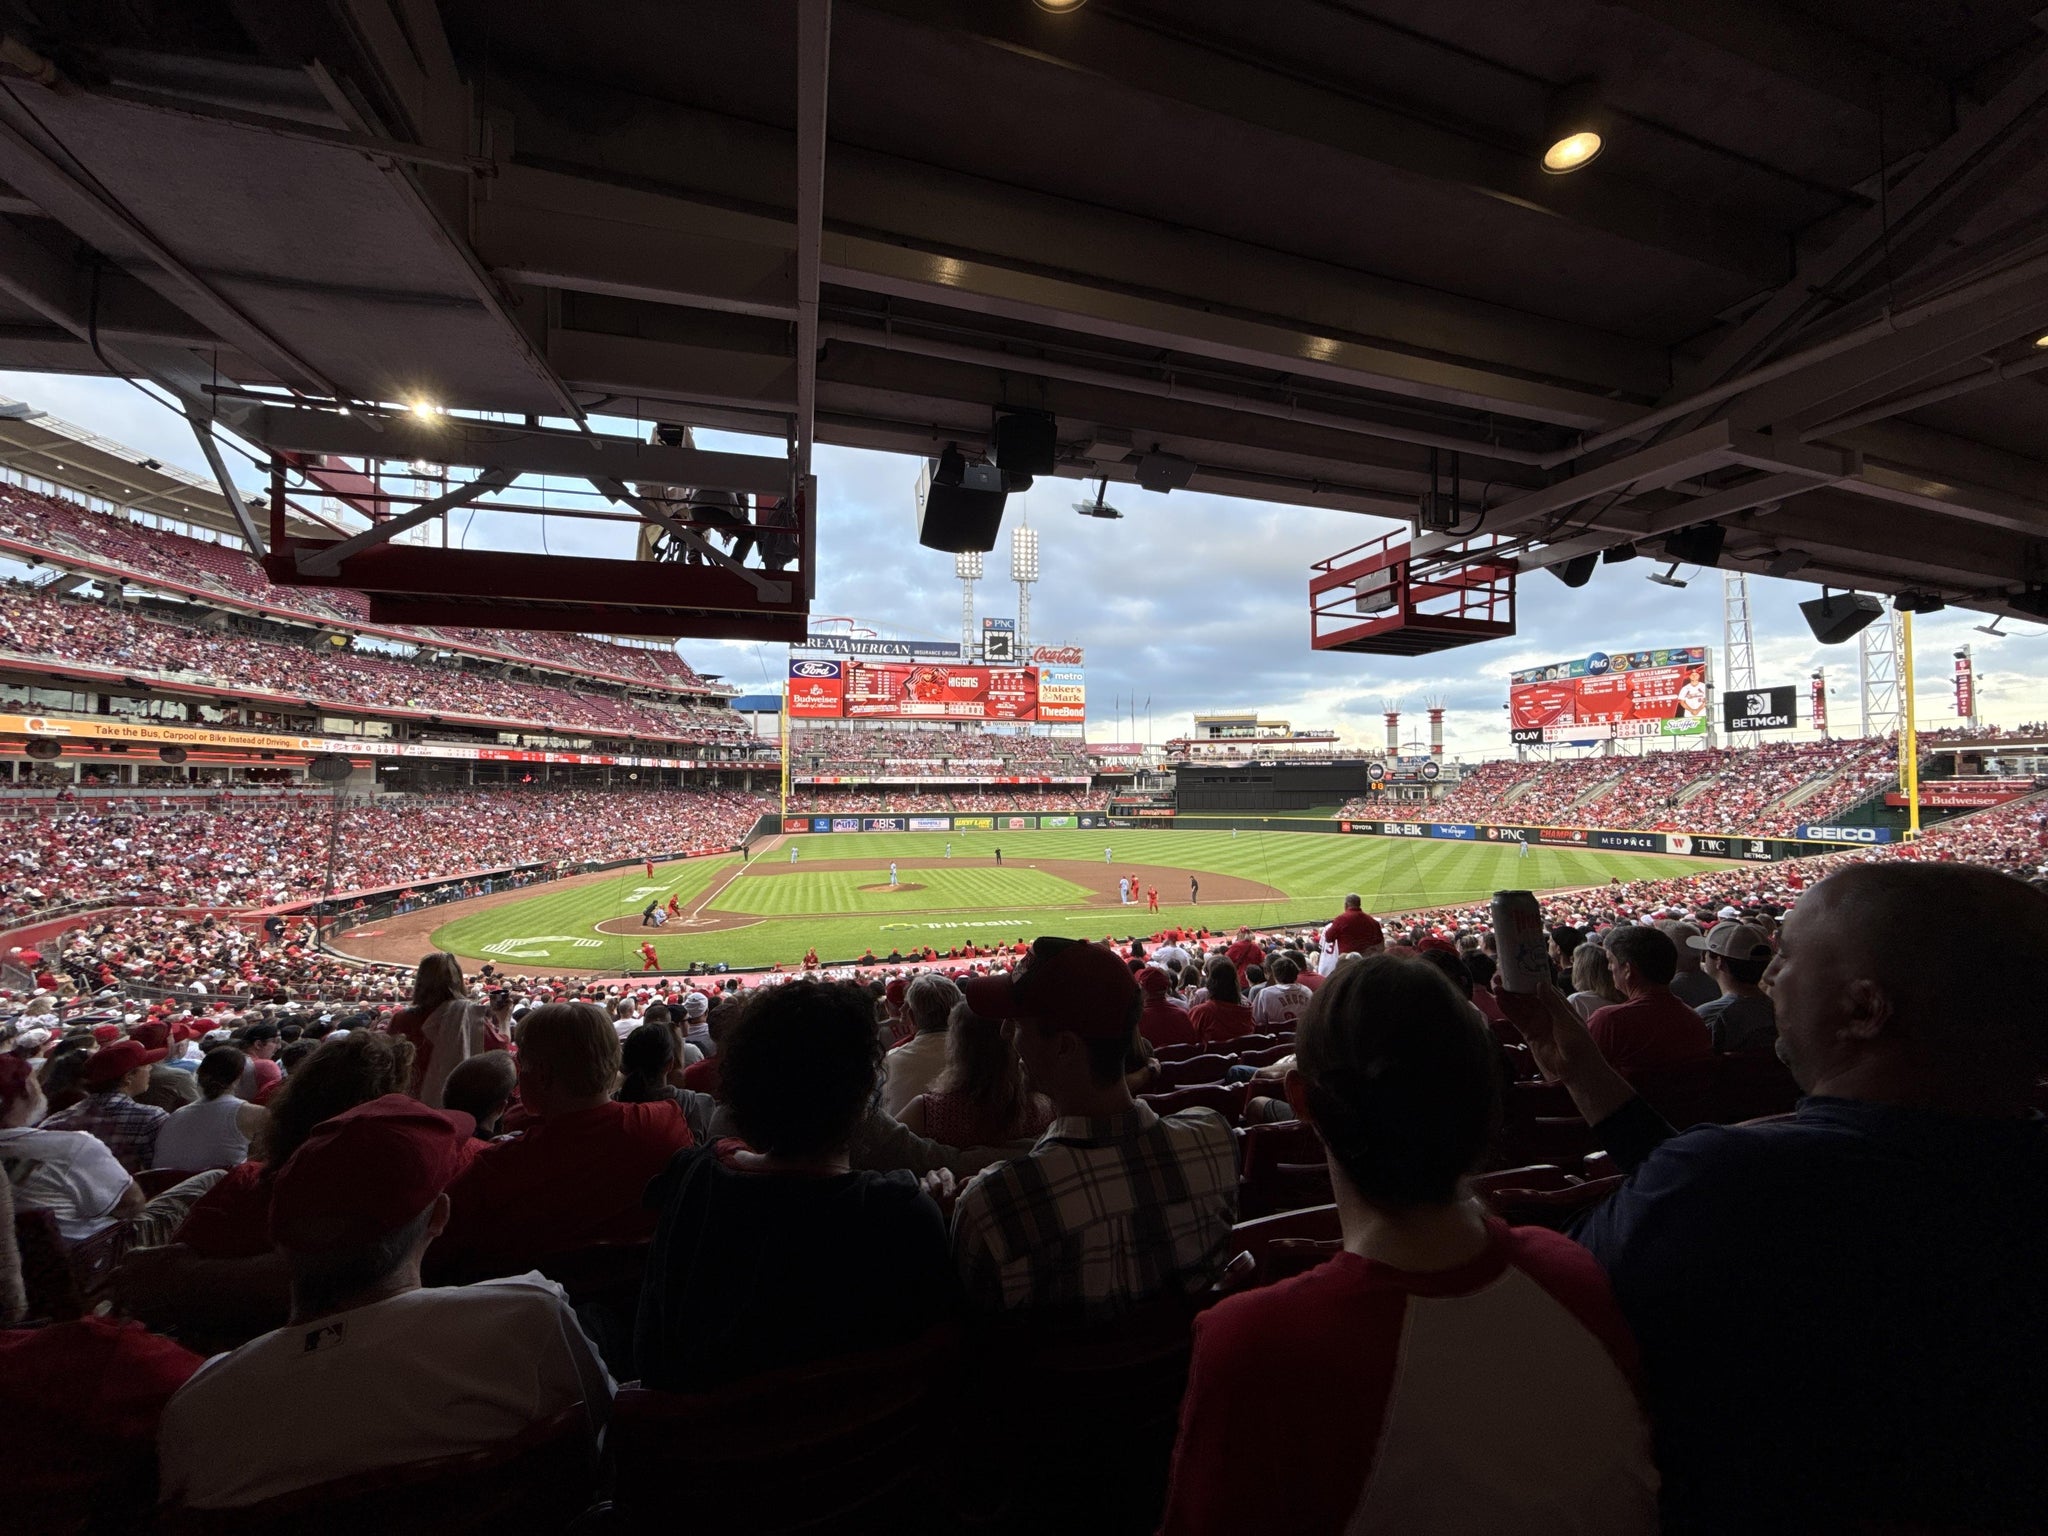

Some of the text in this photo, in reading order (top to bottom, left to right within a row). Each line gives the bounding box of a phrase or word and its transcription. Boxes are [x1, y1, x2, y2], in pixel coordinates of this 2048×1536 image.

[994, 619, 1014, 628] PNC
[838, 640, 911, 654] AMERICAN
[1034, 646, 1082, 664] Coca-Cola
[801, 663, 829, 675] Ford
[1590, 659, 1608, 669] P&G
[948, 677, 979, 688] HIGGINS
[1043, 685, 1081, 693] Maker's
[794, 694, 838, 703] Budweiser
[1053, 694, 1081, 702] Mark
[1041, 706, 1084, 716] ThreeBond
[1667, 720, 1698, 731] Swiffer
[1732, 715, 1788, 728] BETMGM
[94, 725, 120, 736] Take
[122, 728, 138, 737] the
[140, 728, 161, 739] Bus,
[163, 730, 197, 743] Carpool
[209, 734, 227, 743] Bike
[228, 735, 256, 745] Instead
[257, 737, 265, 746] of
[266, 738, 293, 748] Driving.
[1515, 731, 1539, 740] OLAY
[1931, 796, 1997, 805] Budweiser
[1500, 829, 1524, 841] PNC
[1806, 826, 1876, 841] GEICO
[1601, 836, 1653, 847] MEDPACE
[1698, 839, 1726, 851] TWC
[1743, 852, 1772, 860] BETMGM
[921, 919, 1033, 929] TriHealth
